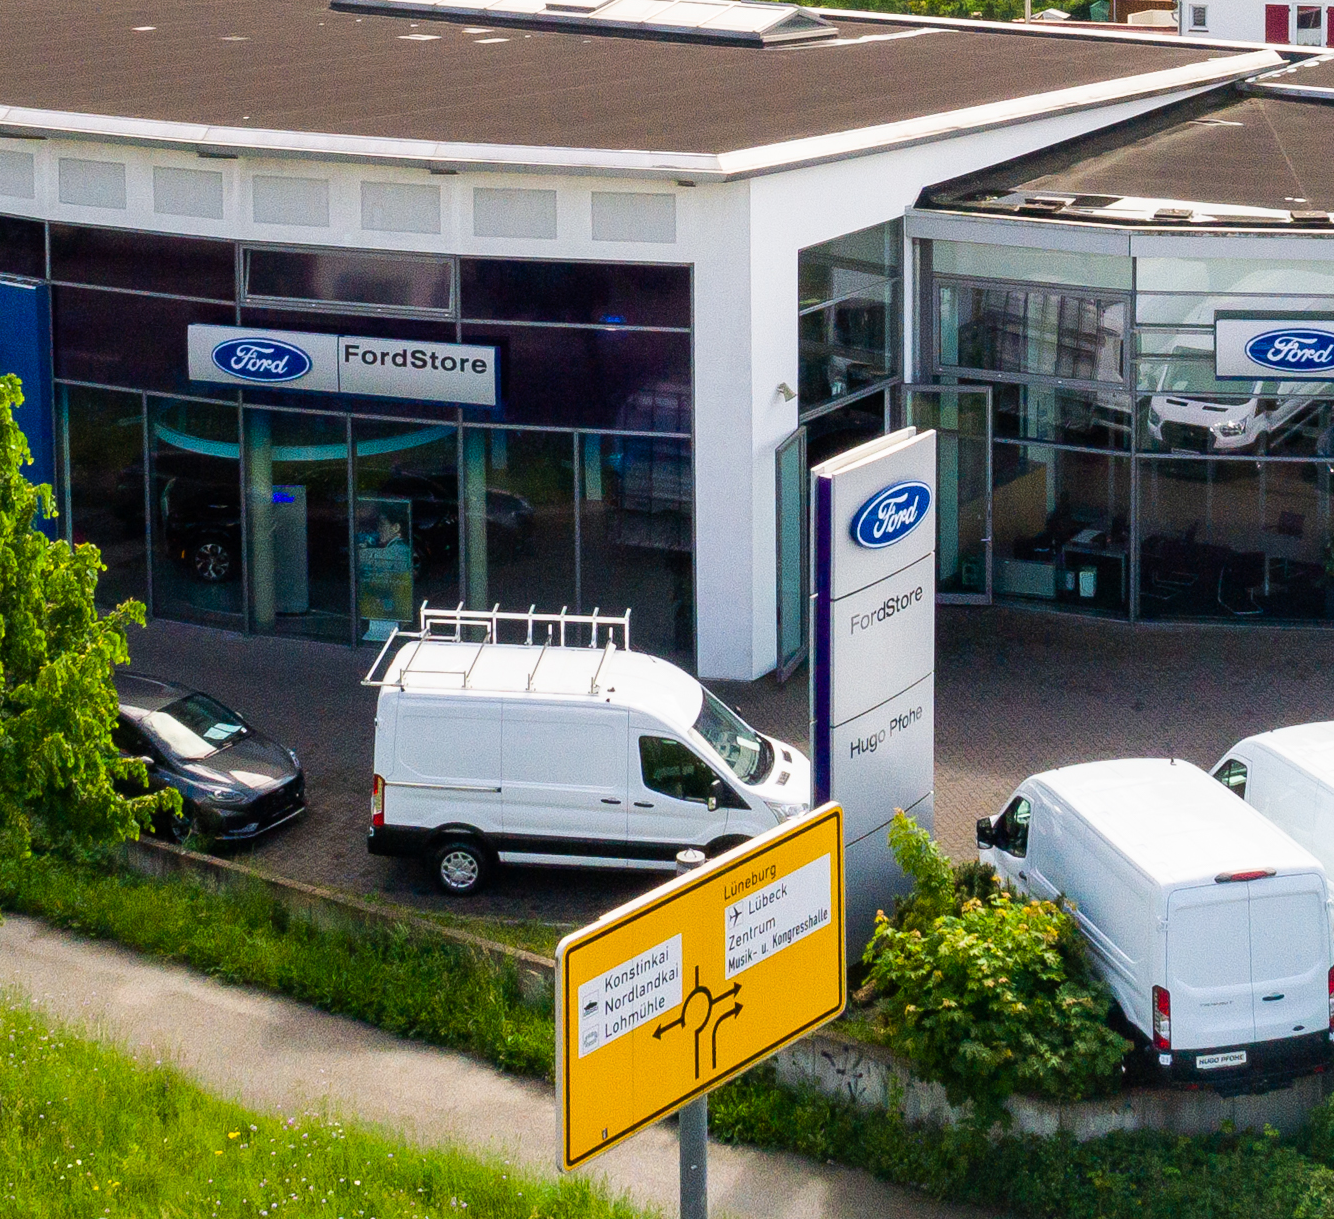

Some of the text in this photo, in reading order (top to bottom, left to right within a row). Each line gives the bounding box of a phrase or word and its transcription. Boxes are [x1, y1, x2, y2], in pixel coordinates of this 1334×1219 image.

[230, 344, 489, 375] Ford FordStore
[1267, 335, 1333, 364] Ford
[872, 492, 919, 540] Ford
[850, 586, 924, 635] FordStore
[850, 704, 923, 759] Hugo Pfohe
[724, 864, 777, 901] Lüneburg
[748, 883, 788, 916] Lübeck
[728, 916, 776, 952] Zentrum
[728, 907, 828, 974] Musik- u. Kongresshalle
[604, 945, 669, 993] Konstinkai
[604, 962, 679, 1016] Nordlandkai
[604, 995, 666, 1039] Lohmühle
[1198, 1053, 1244, 1065] HUGO PFOHE
